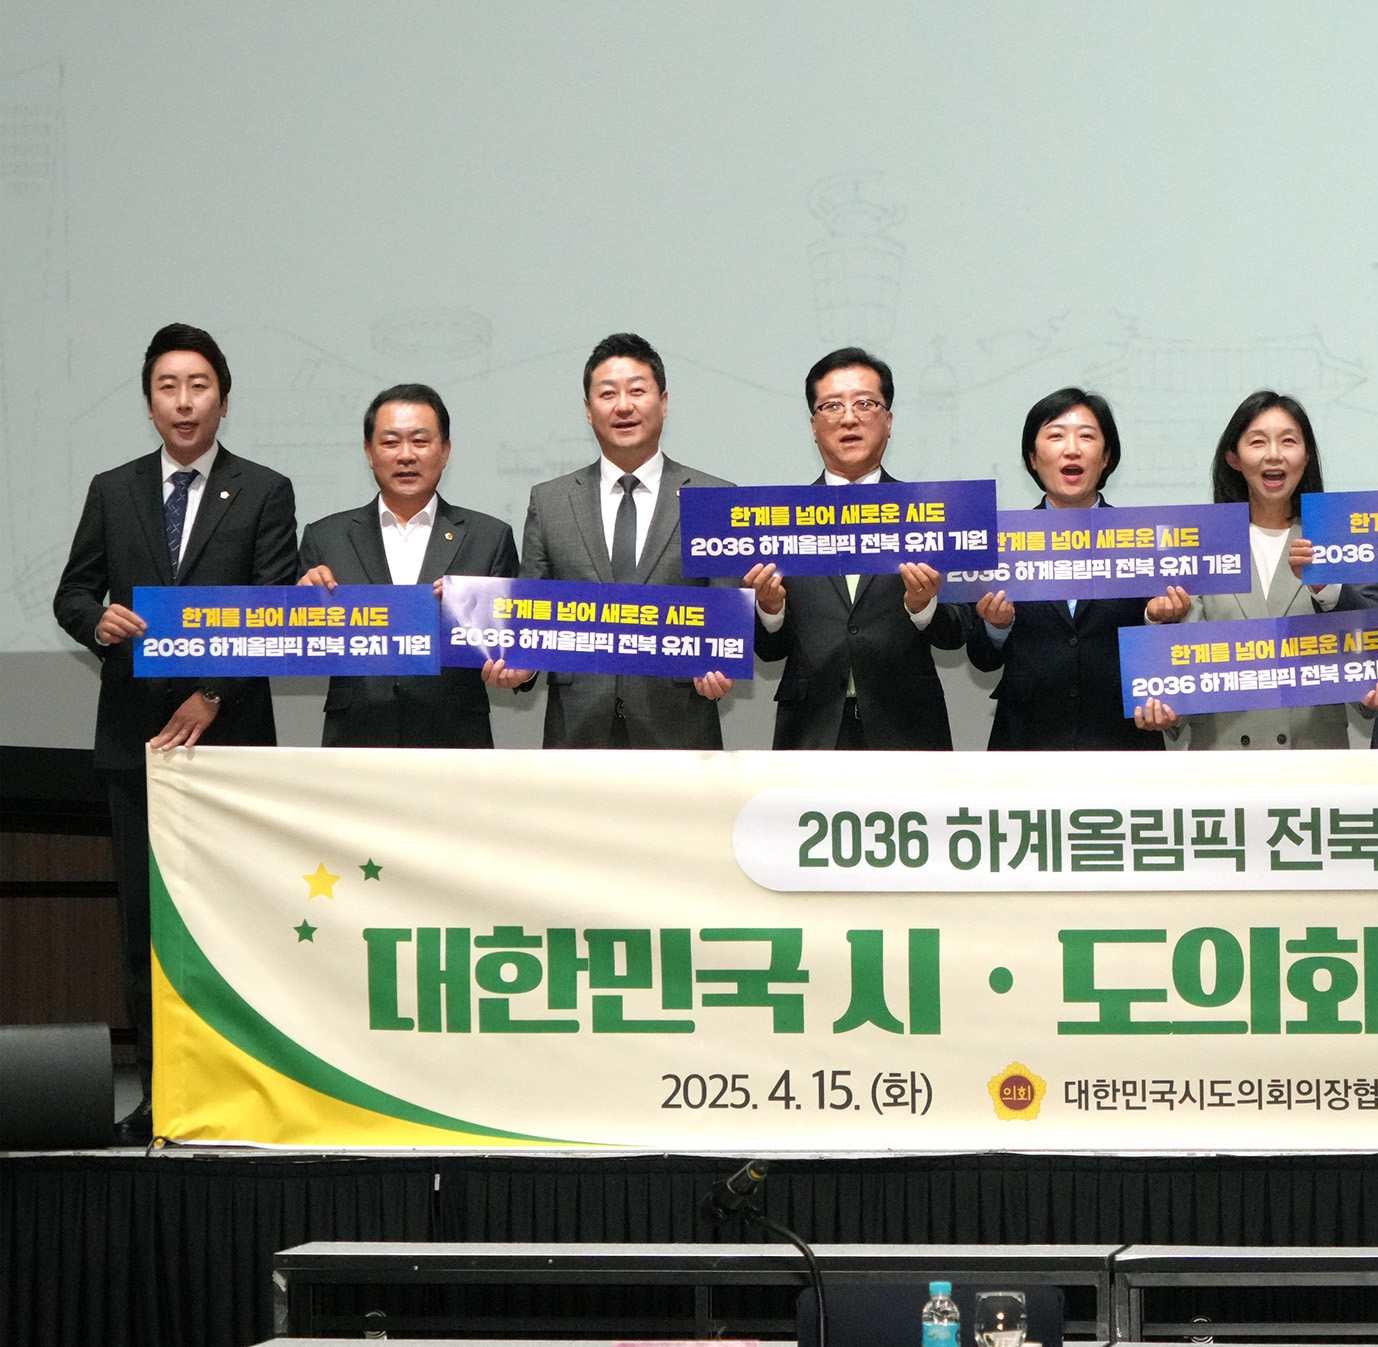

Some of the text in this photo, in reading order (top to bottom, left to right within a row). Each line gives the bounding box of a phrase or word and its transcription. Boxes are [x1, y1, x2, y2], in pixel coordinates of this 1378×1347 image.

[731, 502, 945, 527] 한계를 넘어 새로운 시도
[691, 529, 987, 556] 2036 하계올림픽 전북 유치 기원
[1052, 530, 1090, 550] 넘어
[1097, 528, 1154, 549] 새로운
[1160, 528, 1200, 548] 시도
[1312, 543, 1375, 564] 2036
[1015, 558, 1111, 581] 하계올림픽
[1116, 558, 1154, 578] 전북
[1160, 555, 1197, 576] 유치
[1203, 554, 1241, 575] 기원
[183, 606, 388, 628] 한계를 넘어 새로운 시도
[493, 597, 704, 626] 한계를 넘어 새로운 시도
[144, 635, 430, 657] 2036 하계올림픽 전북 유치 기원
[451, 628, 743, 658] 2036 하계올림픽 전북 유치 기원
[1171, 642, 1229, 666] 한계를
[1236, 639, 1275, 661] 넘어
[1281, 634, 1337, 658] 새로운
[1132, 675, 1195, 697] 2036
[1201, 667, 1296, 692] 하계올림픽
[1301, 664, 1339, 686] 전북
[799, 811, 928, 867] 2036
[947, 808, 1245, 872] 하계올림픽
[364, 927, 809, 1032] 대한민국
[834, 929, 940, 1033] 시
[661, 1070, 932, 1115] 2025. 4. 15. (화)
[1002, 1086, 1031, 1101] 의회
